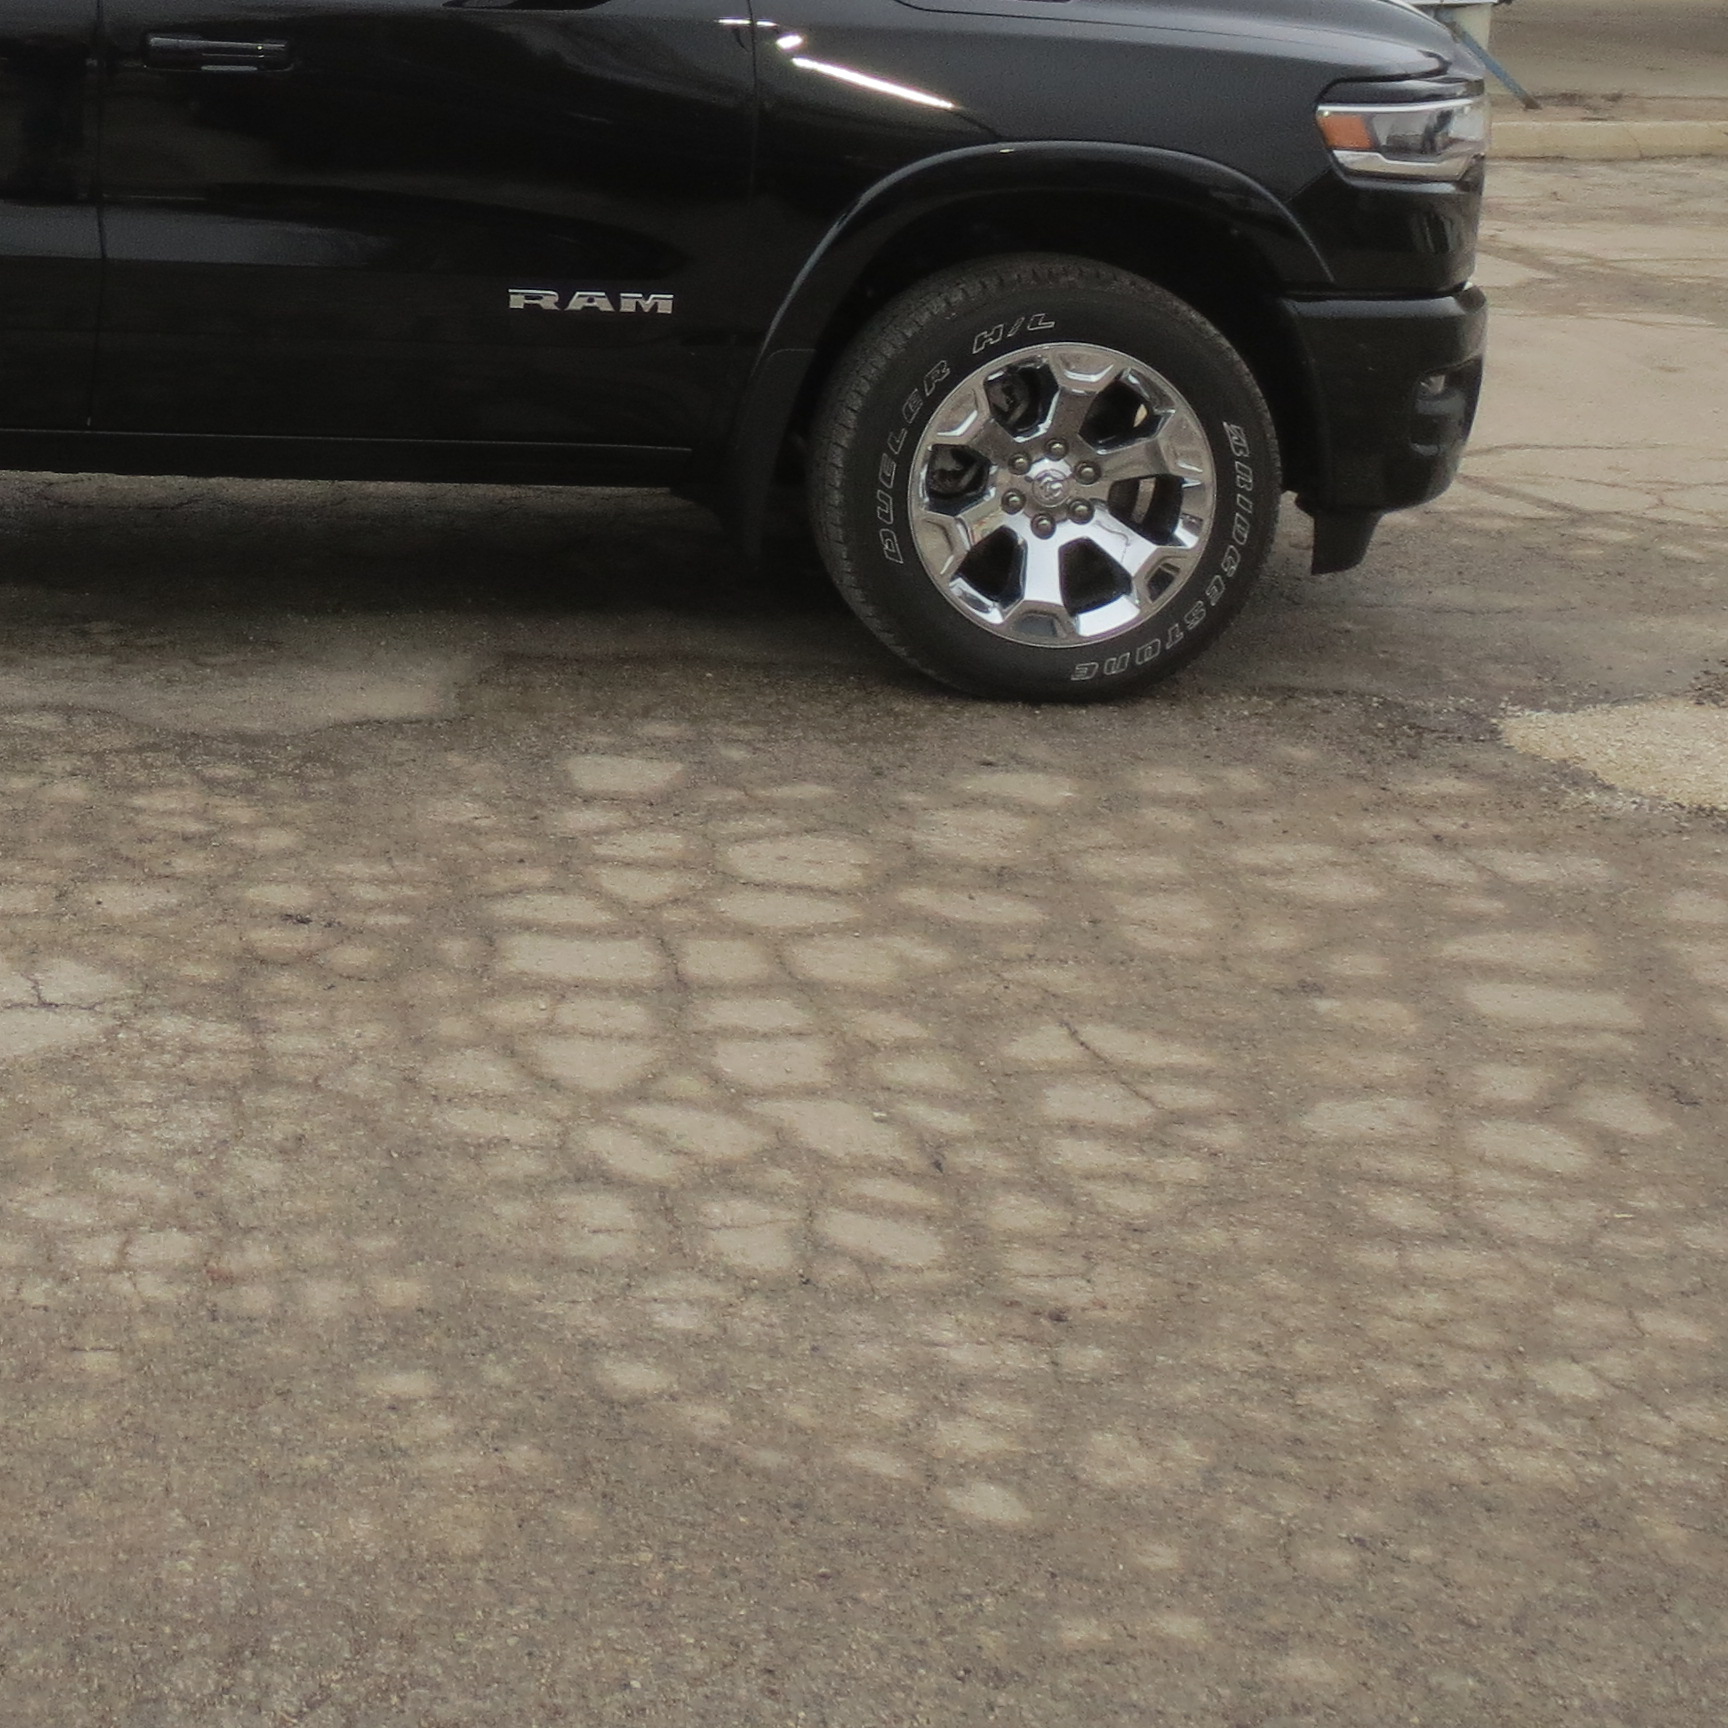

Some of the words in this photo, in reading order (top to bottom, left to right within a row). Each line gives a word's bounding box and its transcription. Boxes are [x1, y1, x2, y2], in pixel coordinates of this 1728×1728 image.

[507, 288, 674, 314] RAM
[875, 360, 951, 565] DUELER
[1071, 421, 1254, 681] BRIDGESTONE
